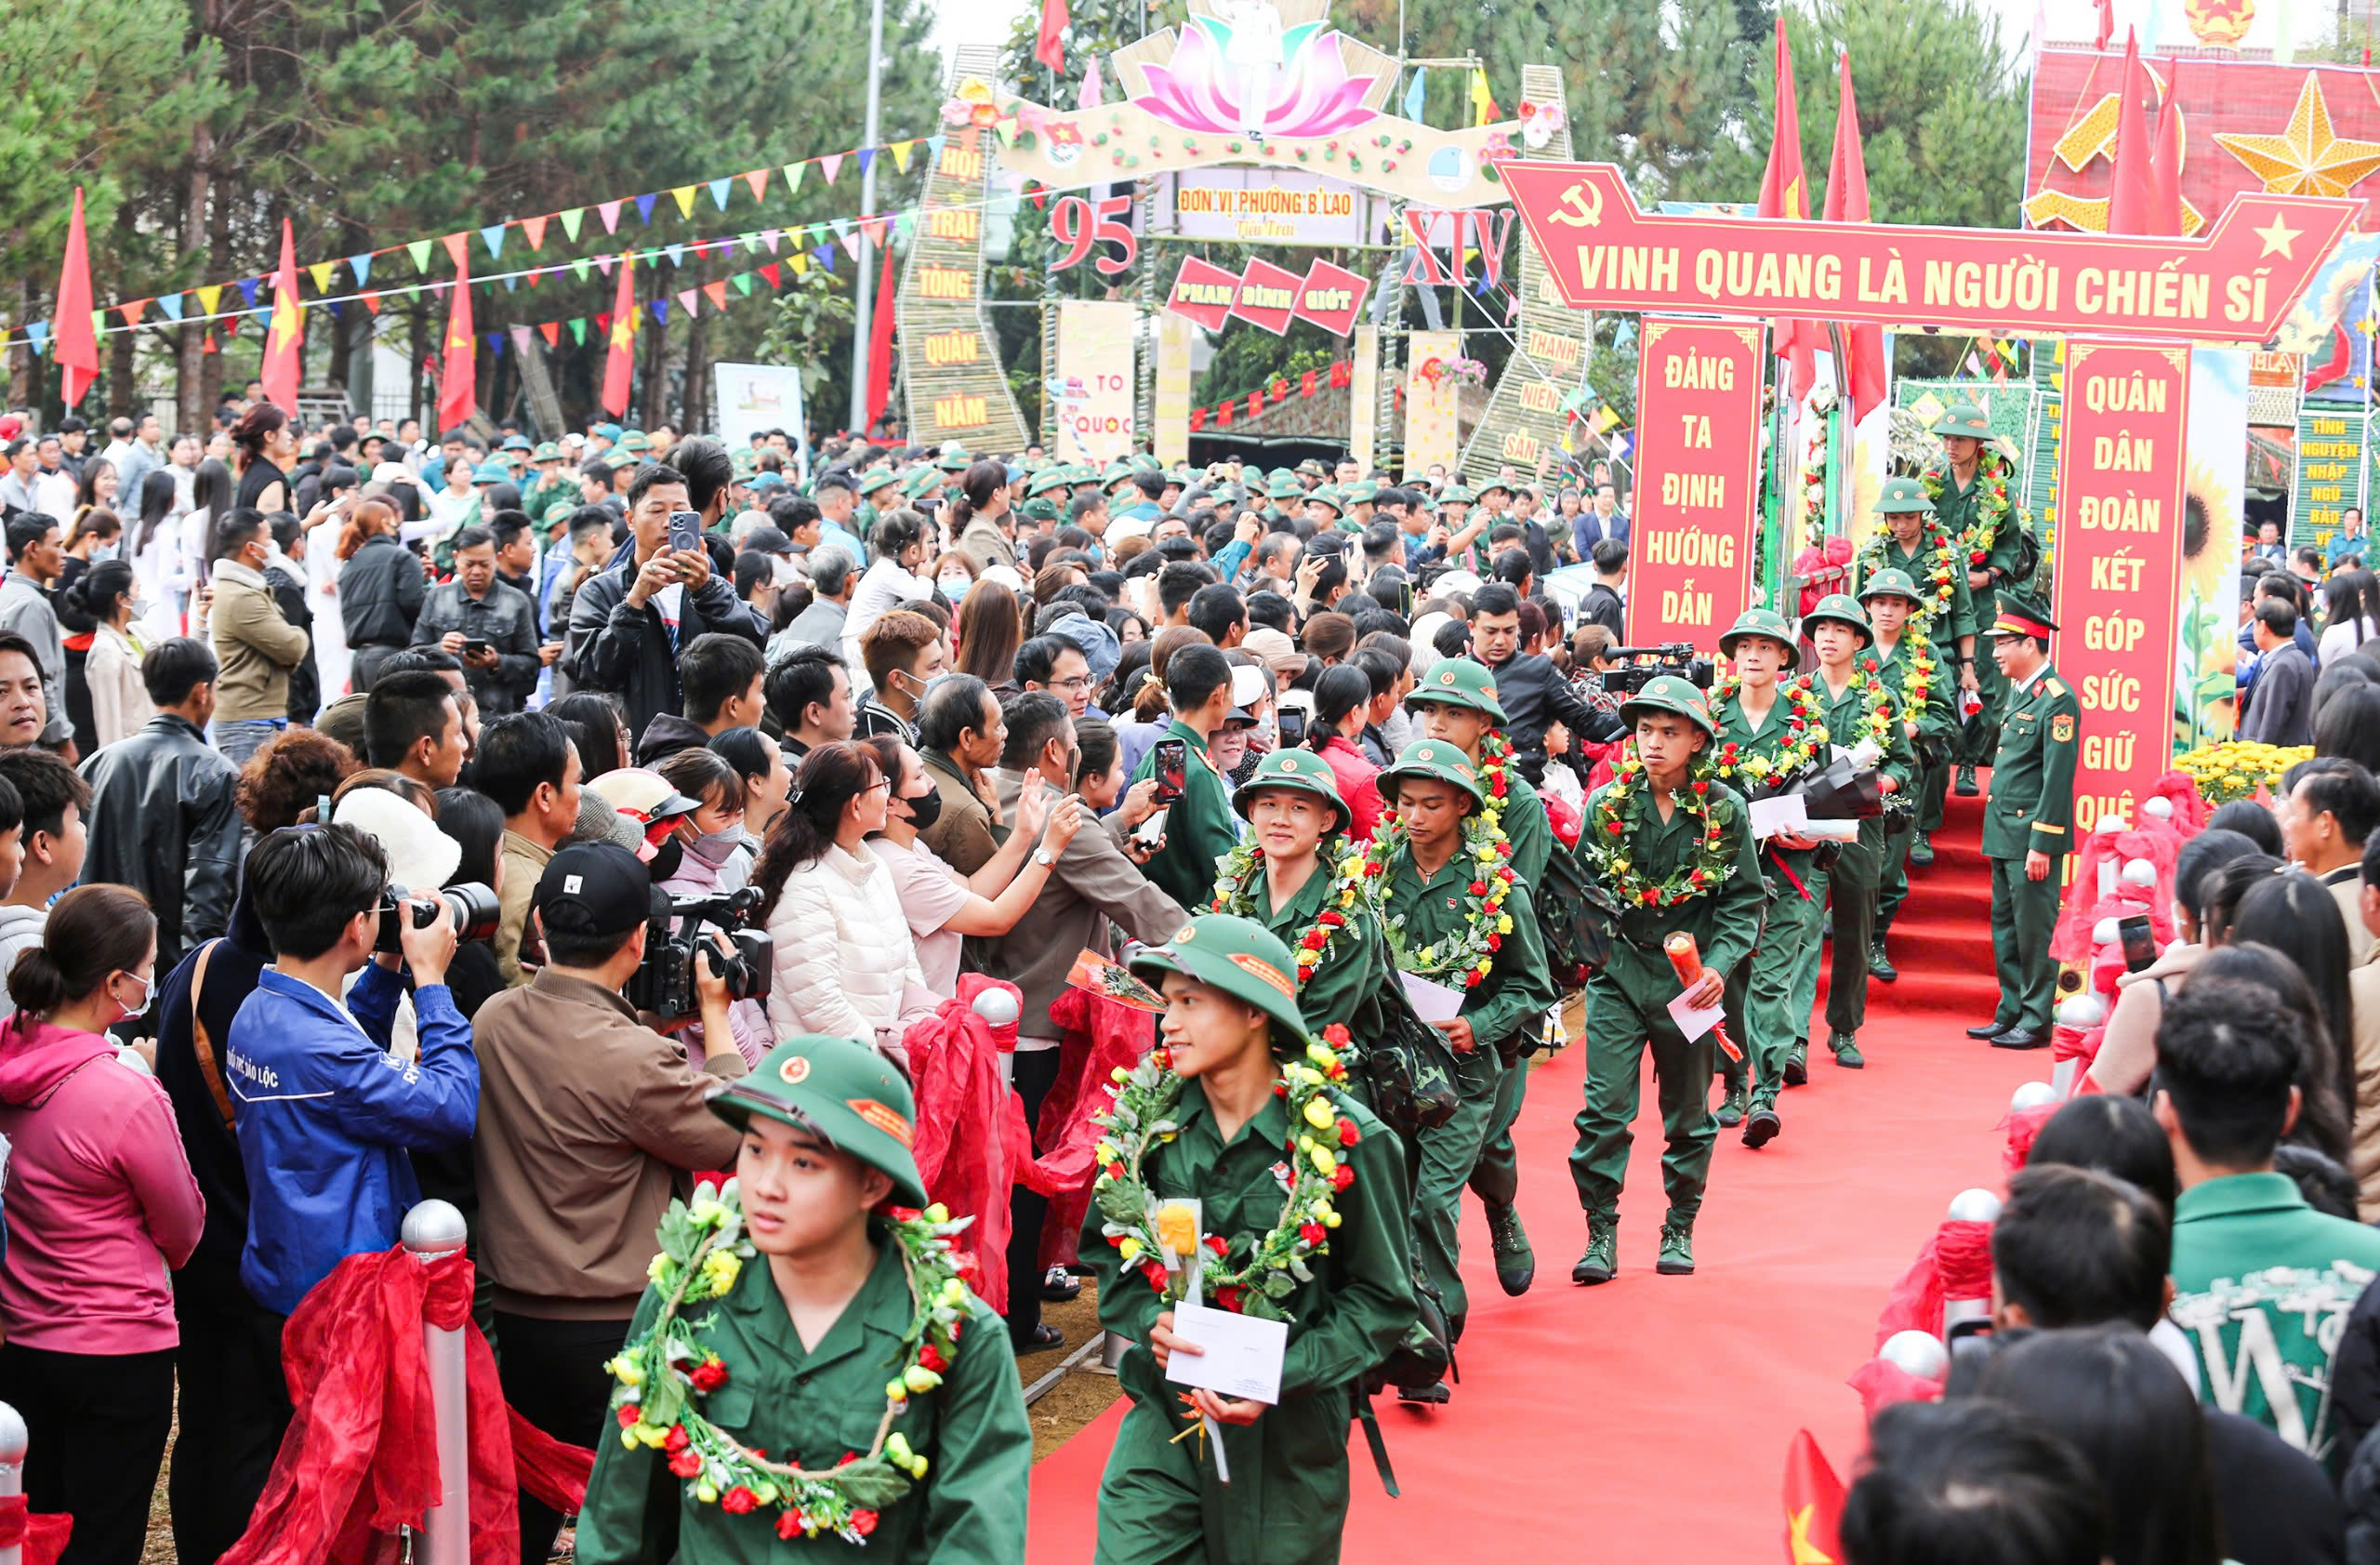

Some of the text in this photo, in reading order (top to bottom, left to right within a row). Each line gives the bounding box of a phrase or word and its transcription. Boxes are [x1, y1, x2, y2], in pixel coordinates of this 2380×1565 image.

[1179, 188, 1212, 213] ĐƠN
[1218, 191, 1233, 218] VỊ
[1238, 185, 1302, 215] PHƯỜNG
[1049, 195, 1138, 275] 95
[1400, 207, 1516, 289] XIV
[1176, 282, 1234, 306] PHAN
[1240, 283, 1293, 311] ĐÌNH
[1577, 245, 2272, 323] VINH QUANG LÀ NGƯỜI CHIẾN SĨ
[924, 327, 978, 368] QUÂN
[1529, 332, 1578, 362] THANH
[1664, 345, 1735, 391] ĐẢNG
[933, 390, 988, 429] NĂM
[2085, 369, 2167, 415] QUÂN
[1681, 414, 1712, 449] TA
[2094, 429, 2153, 472] DÂN
[1661, 472, 1726, 514] ĐỊNH
[2079, 489, 2162, 533] ĐOÀN
[1646, 524, 1735, 568] HƯỚNG
[2090, 545, 2147, 592] KẾT
[1660, 577, 1713, 626] DẪN
[2083, 609, 2146, 652] GÓP
[2081, 669, 2142, 713] SỨC
[2082, 730, 2137, 773] GIỮ
[2075, 789, 2135, 833] QUÊ
[258, 1065, 279, 1090] LỘC
